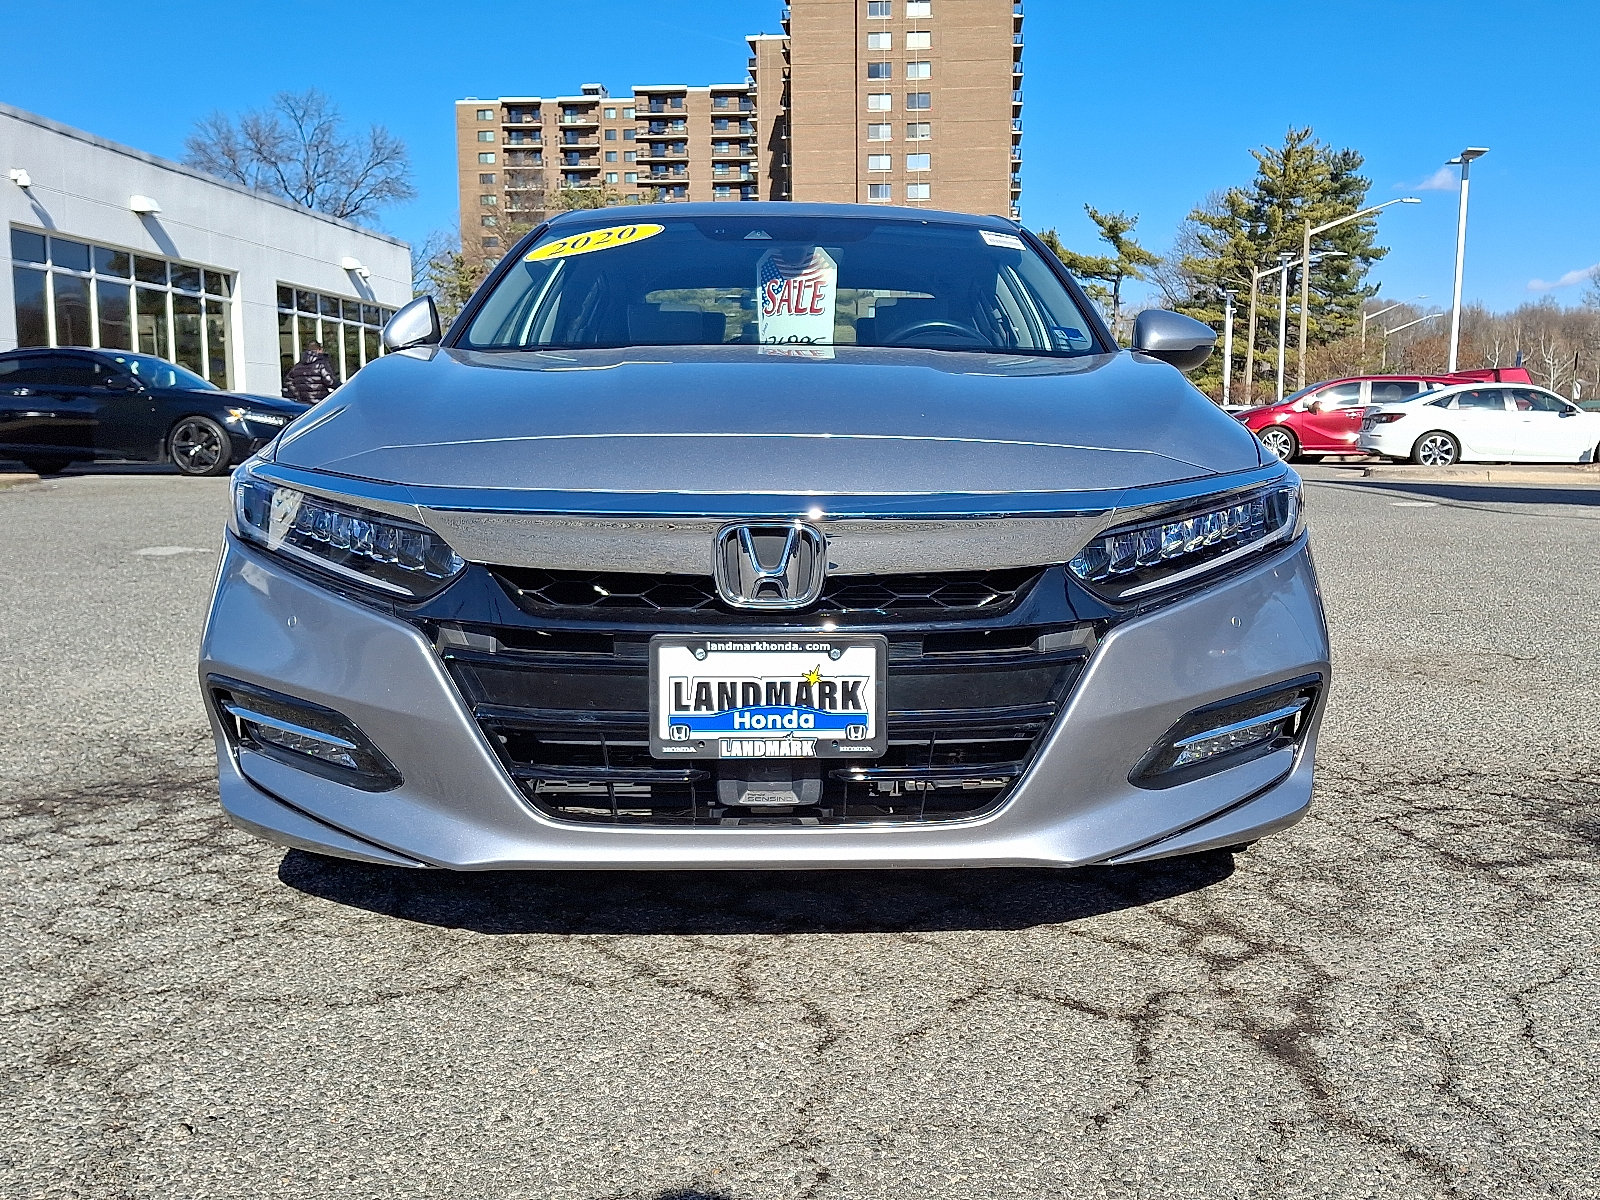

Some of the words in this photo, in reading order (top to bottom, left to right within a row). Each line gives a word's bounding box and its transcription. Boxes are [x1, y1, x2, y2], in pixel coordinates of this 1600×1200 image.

[547, 227, 637, 257] 2020
[763, 279, 828, 316] SALE
[674, 681, 862, 711] LANDMARK
[733, 710, 815, 729] Honda
[720, 739, 815, 757] LANDMARK
